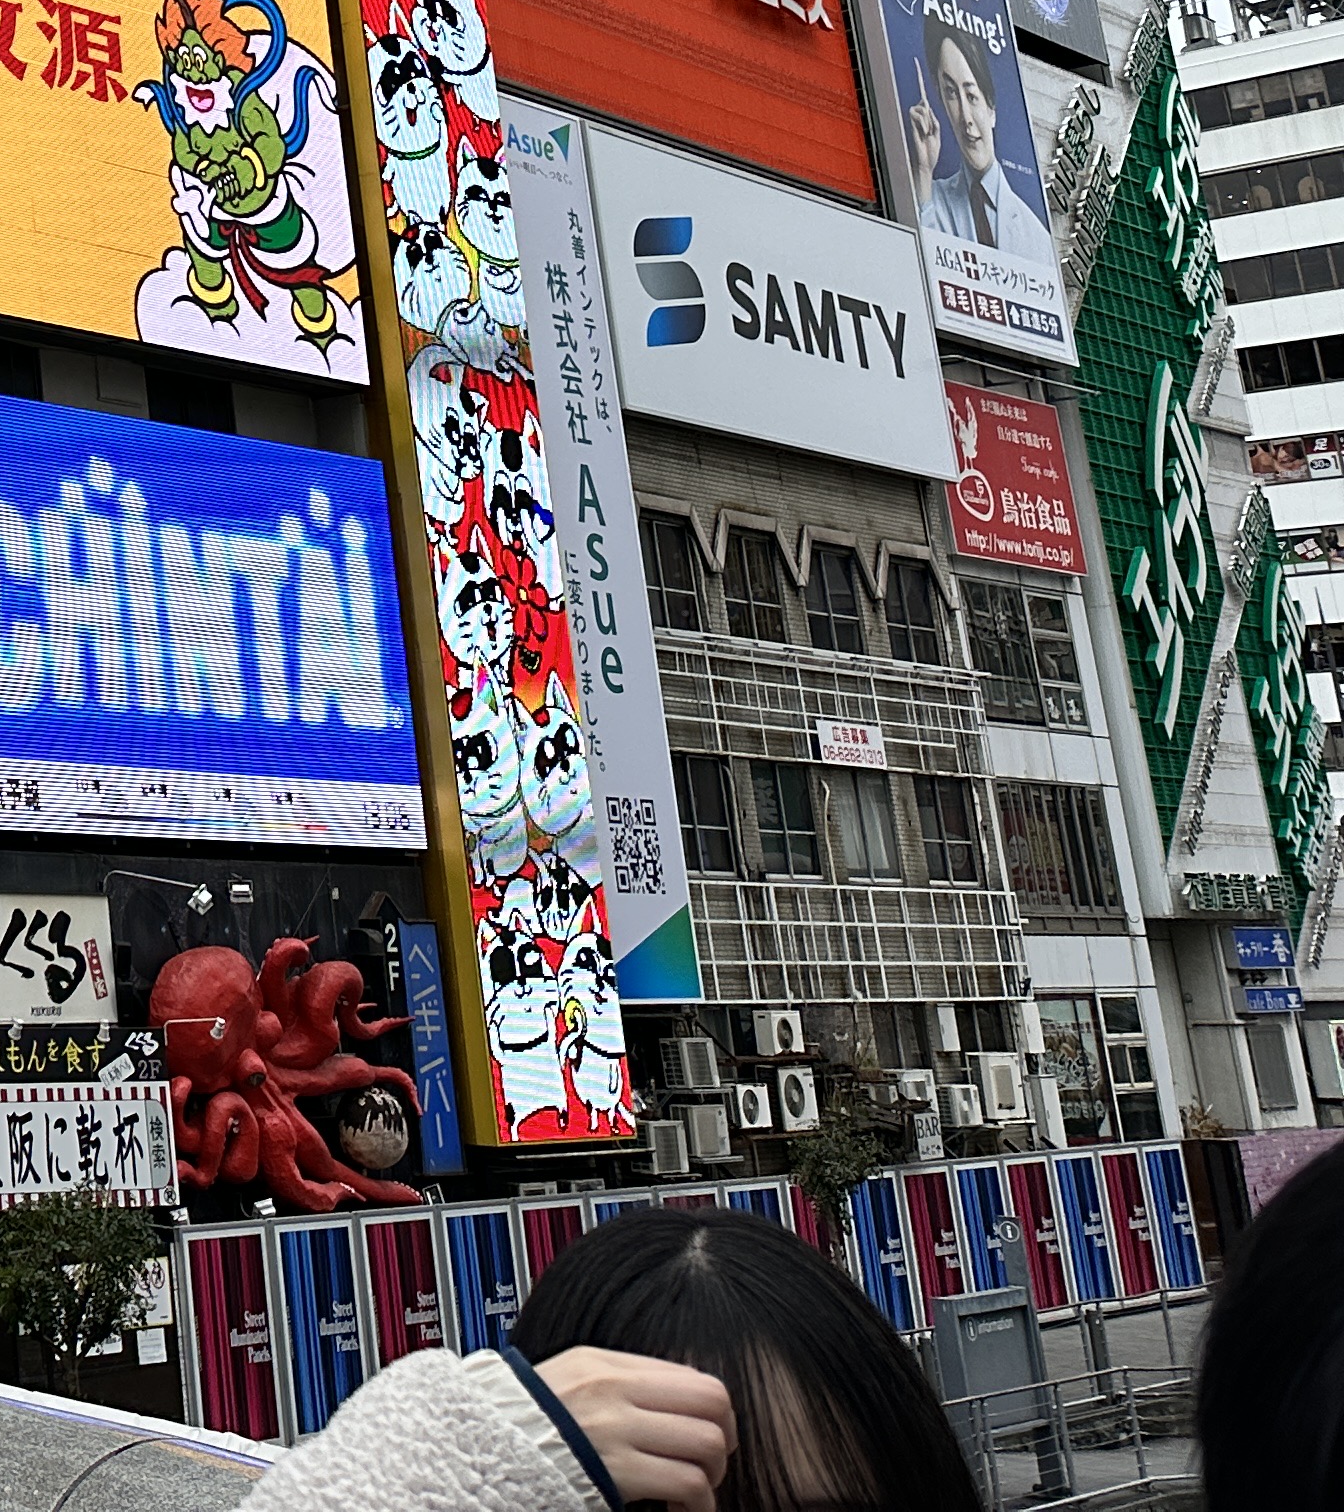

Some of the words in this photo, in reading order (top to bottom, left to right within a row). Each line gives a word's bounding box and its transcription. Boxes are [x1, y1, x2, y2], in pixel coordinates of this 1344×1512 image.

[507, 123, 554, 162] Asue
[1145, 72, 1201, 270] エイブル
[934, 245, 965, 274] AGA
[980, 261, 1056, 301] スキンクリニック
[567, 206, 613, 435] 丸善インテックは、
[725, 261, 907, 380] SAMTY
[943, 284, 970, 313] 薄毛
[977, 292, 1004, 322] 発毛
[543, 260, 592, 447] 株式会社
[577, 462, 625, 696] Asue
[1123, 359, 1210, 741] エイブル
[563, 549, 607, 774] に変わりました。
[1250, 560, 1307, 794] エイブル
[822, 744, 885, 766] 06-6262-1313
[831, 725, 869, 746] 広告募集
[384, 922, 400, 992] 2F
[138, 1059, 163, 1080] 2F
[408, 942, 452, 1149] ペンギンバー
[148, 1115, 167, 1170] 検索
[914, 1113, 942, 1140] BAR
[244, 1311, 267, 1329] Street
[332, 1300, 354, 1319] Street
